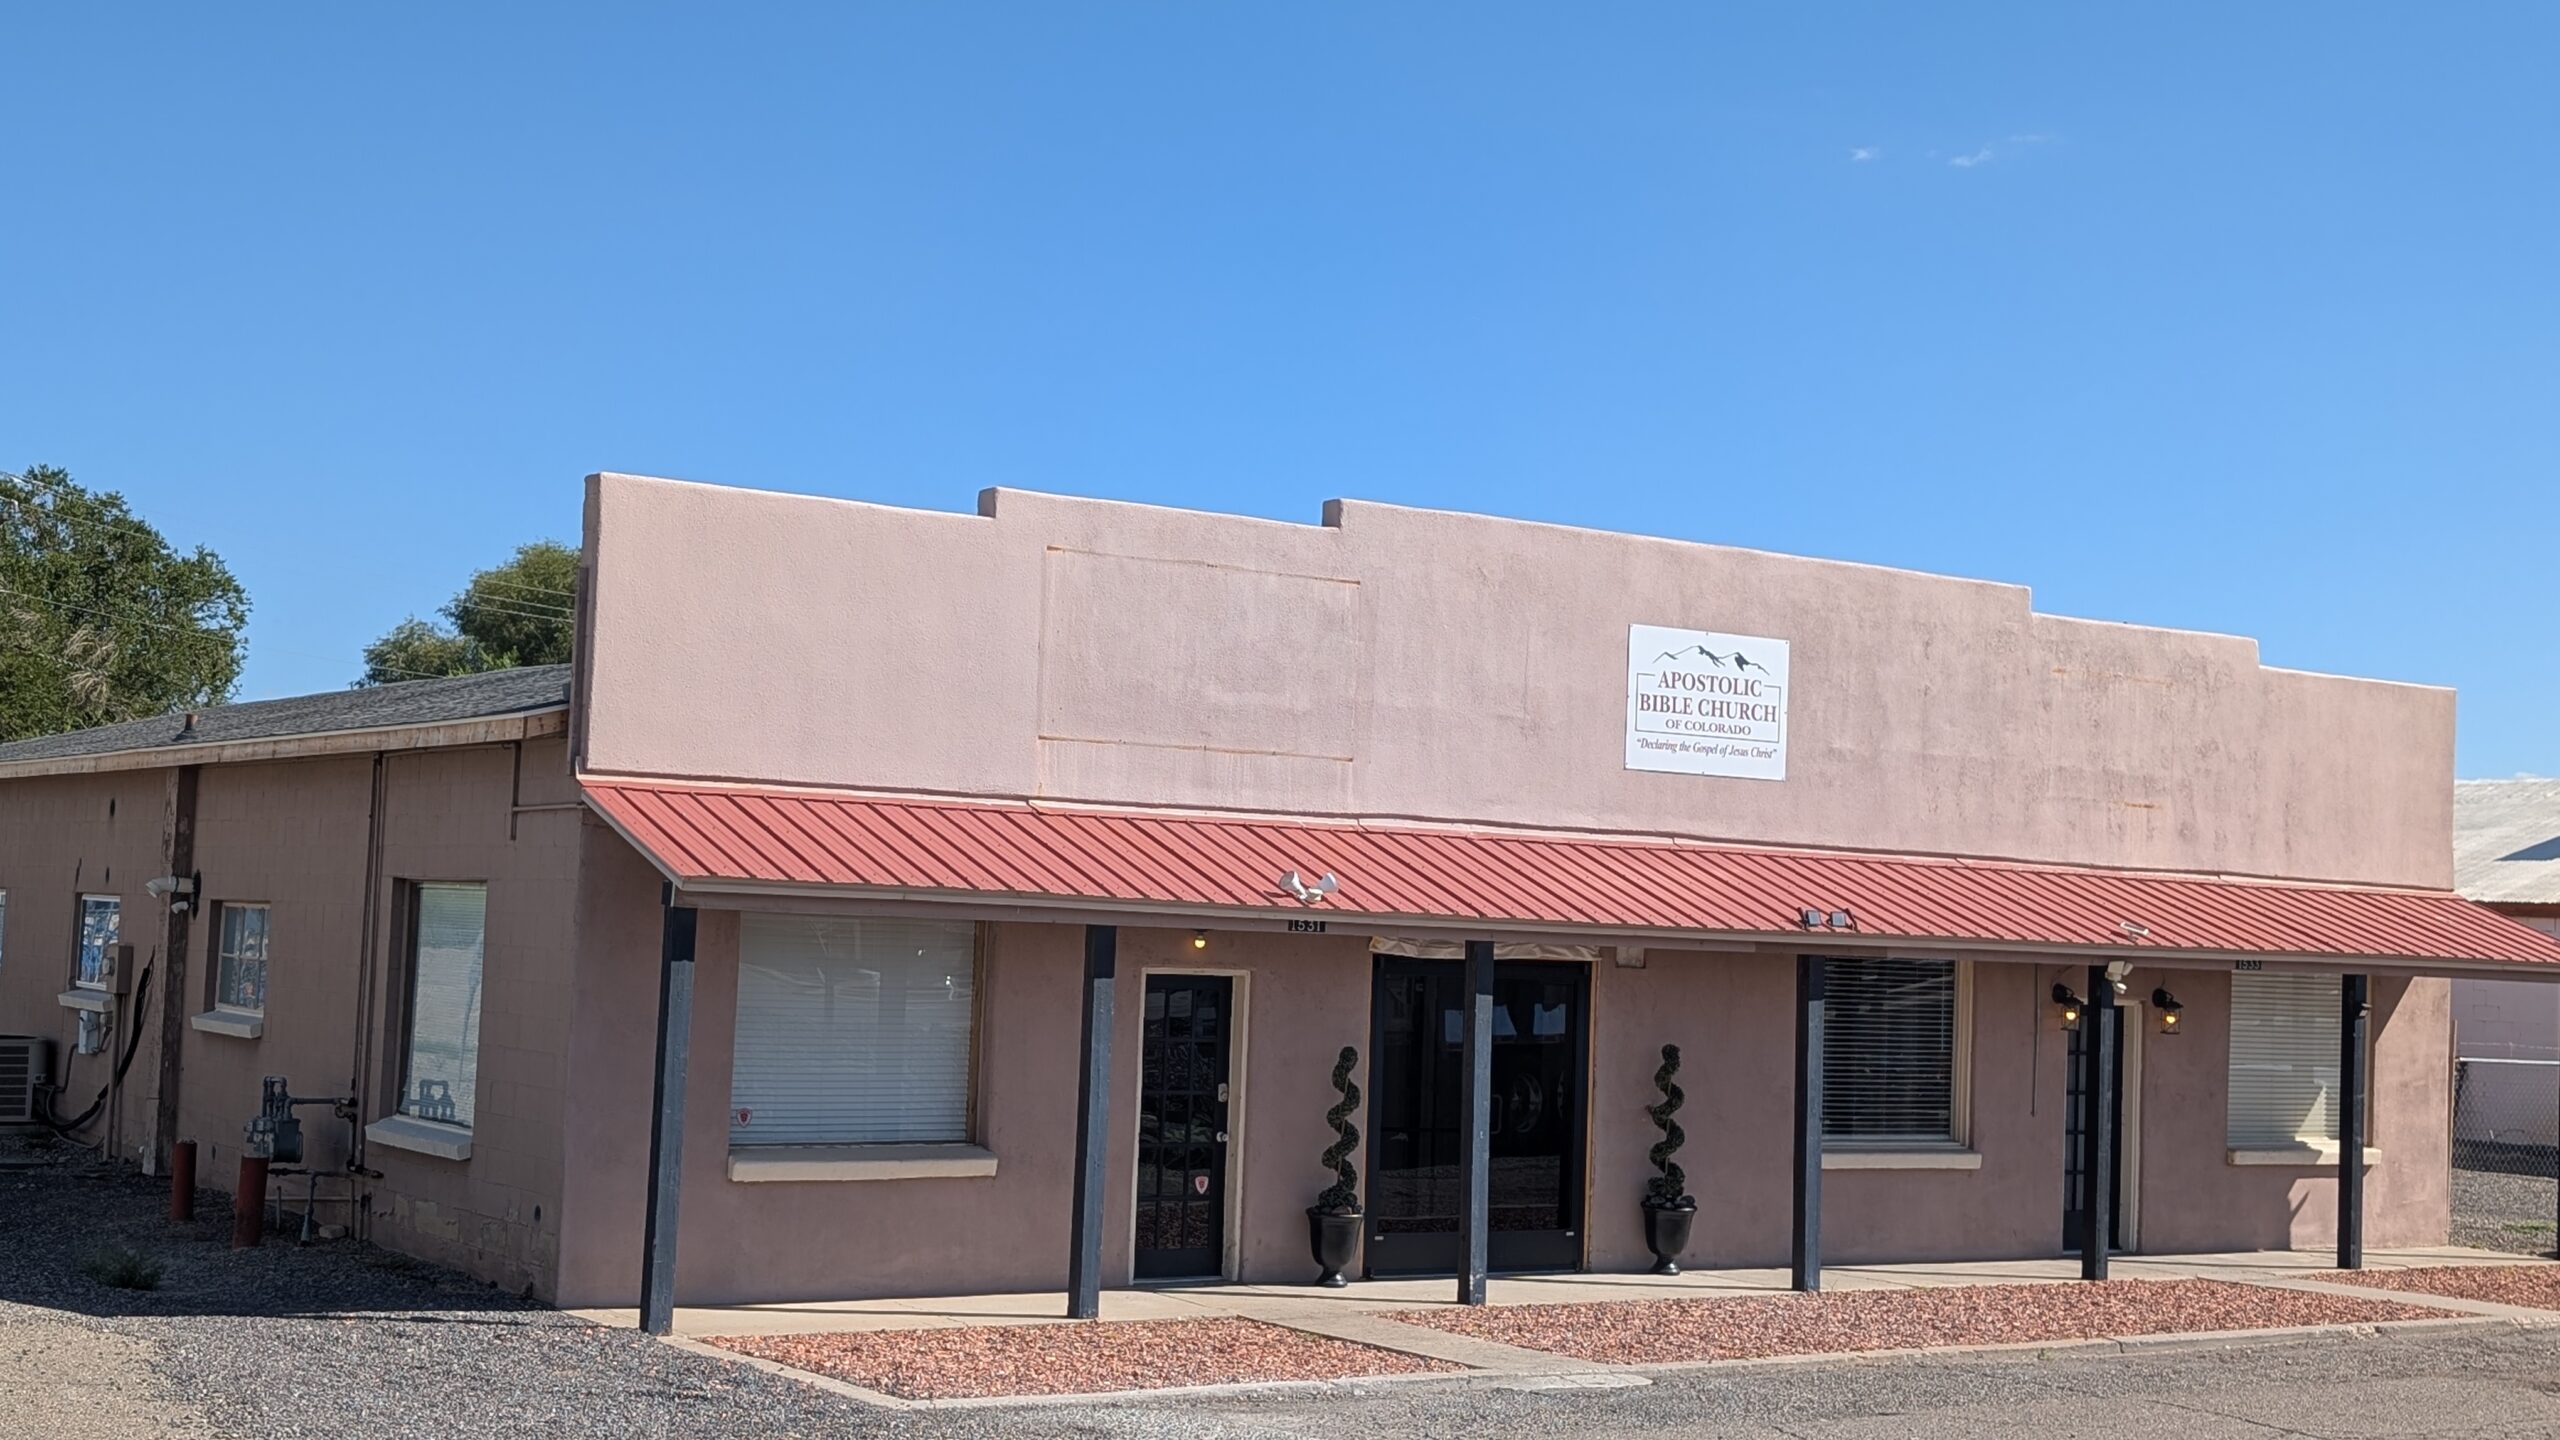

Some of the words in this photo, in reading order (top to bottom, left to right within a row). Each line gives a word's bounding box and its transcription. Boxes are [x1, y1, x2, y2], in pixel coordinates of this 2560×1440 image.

[1657, 670, 1762, 698] APOSTOLIC
[1639, 693, 1693, 715] BIBLE
[1698, 698, 1777, 723] CHURCH
[1665, 718, 1682, 730] OF
[1684, 720, 1751, 736] COLORADO
[1679, 740, 1691, 752] the
[1693, 741, 1719, 757] Gospel
[1719, 744, 1729, 758] of
[1728, 744, 1749, 757] Jesus
[1291, 920, 1321, 932] 1531
